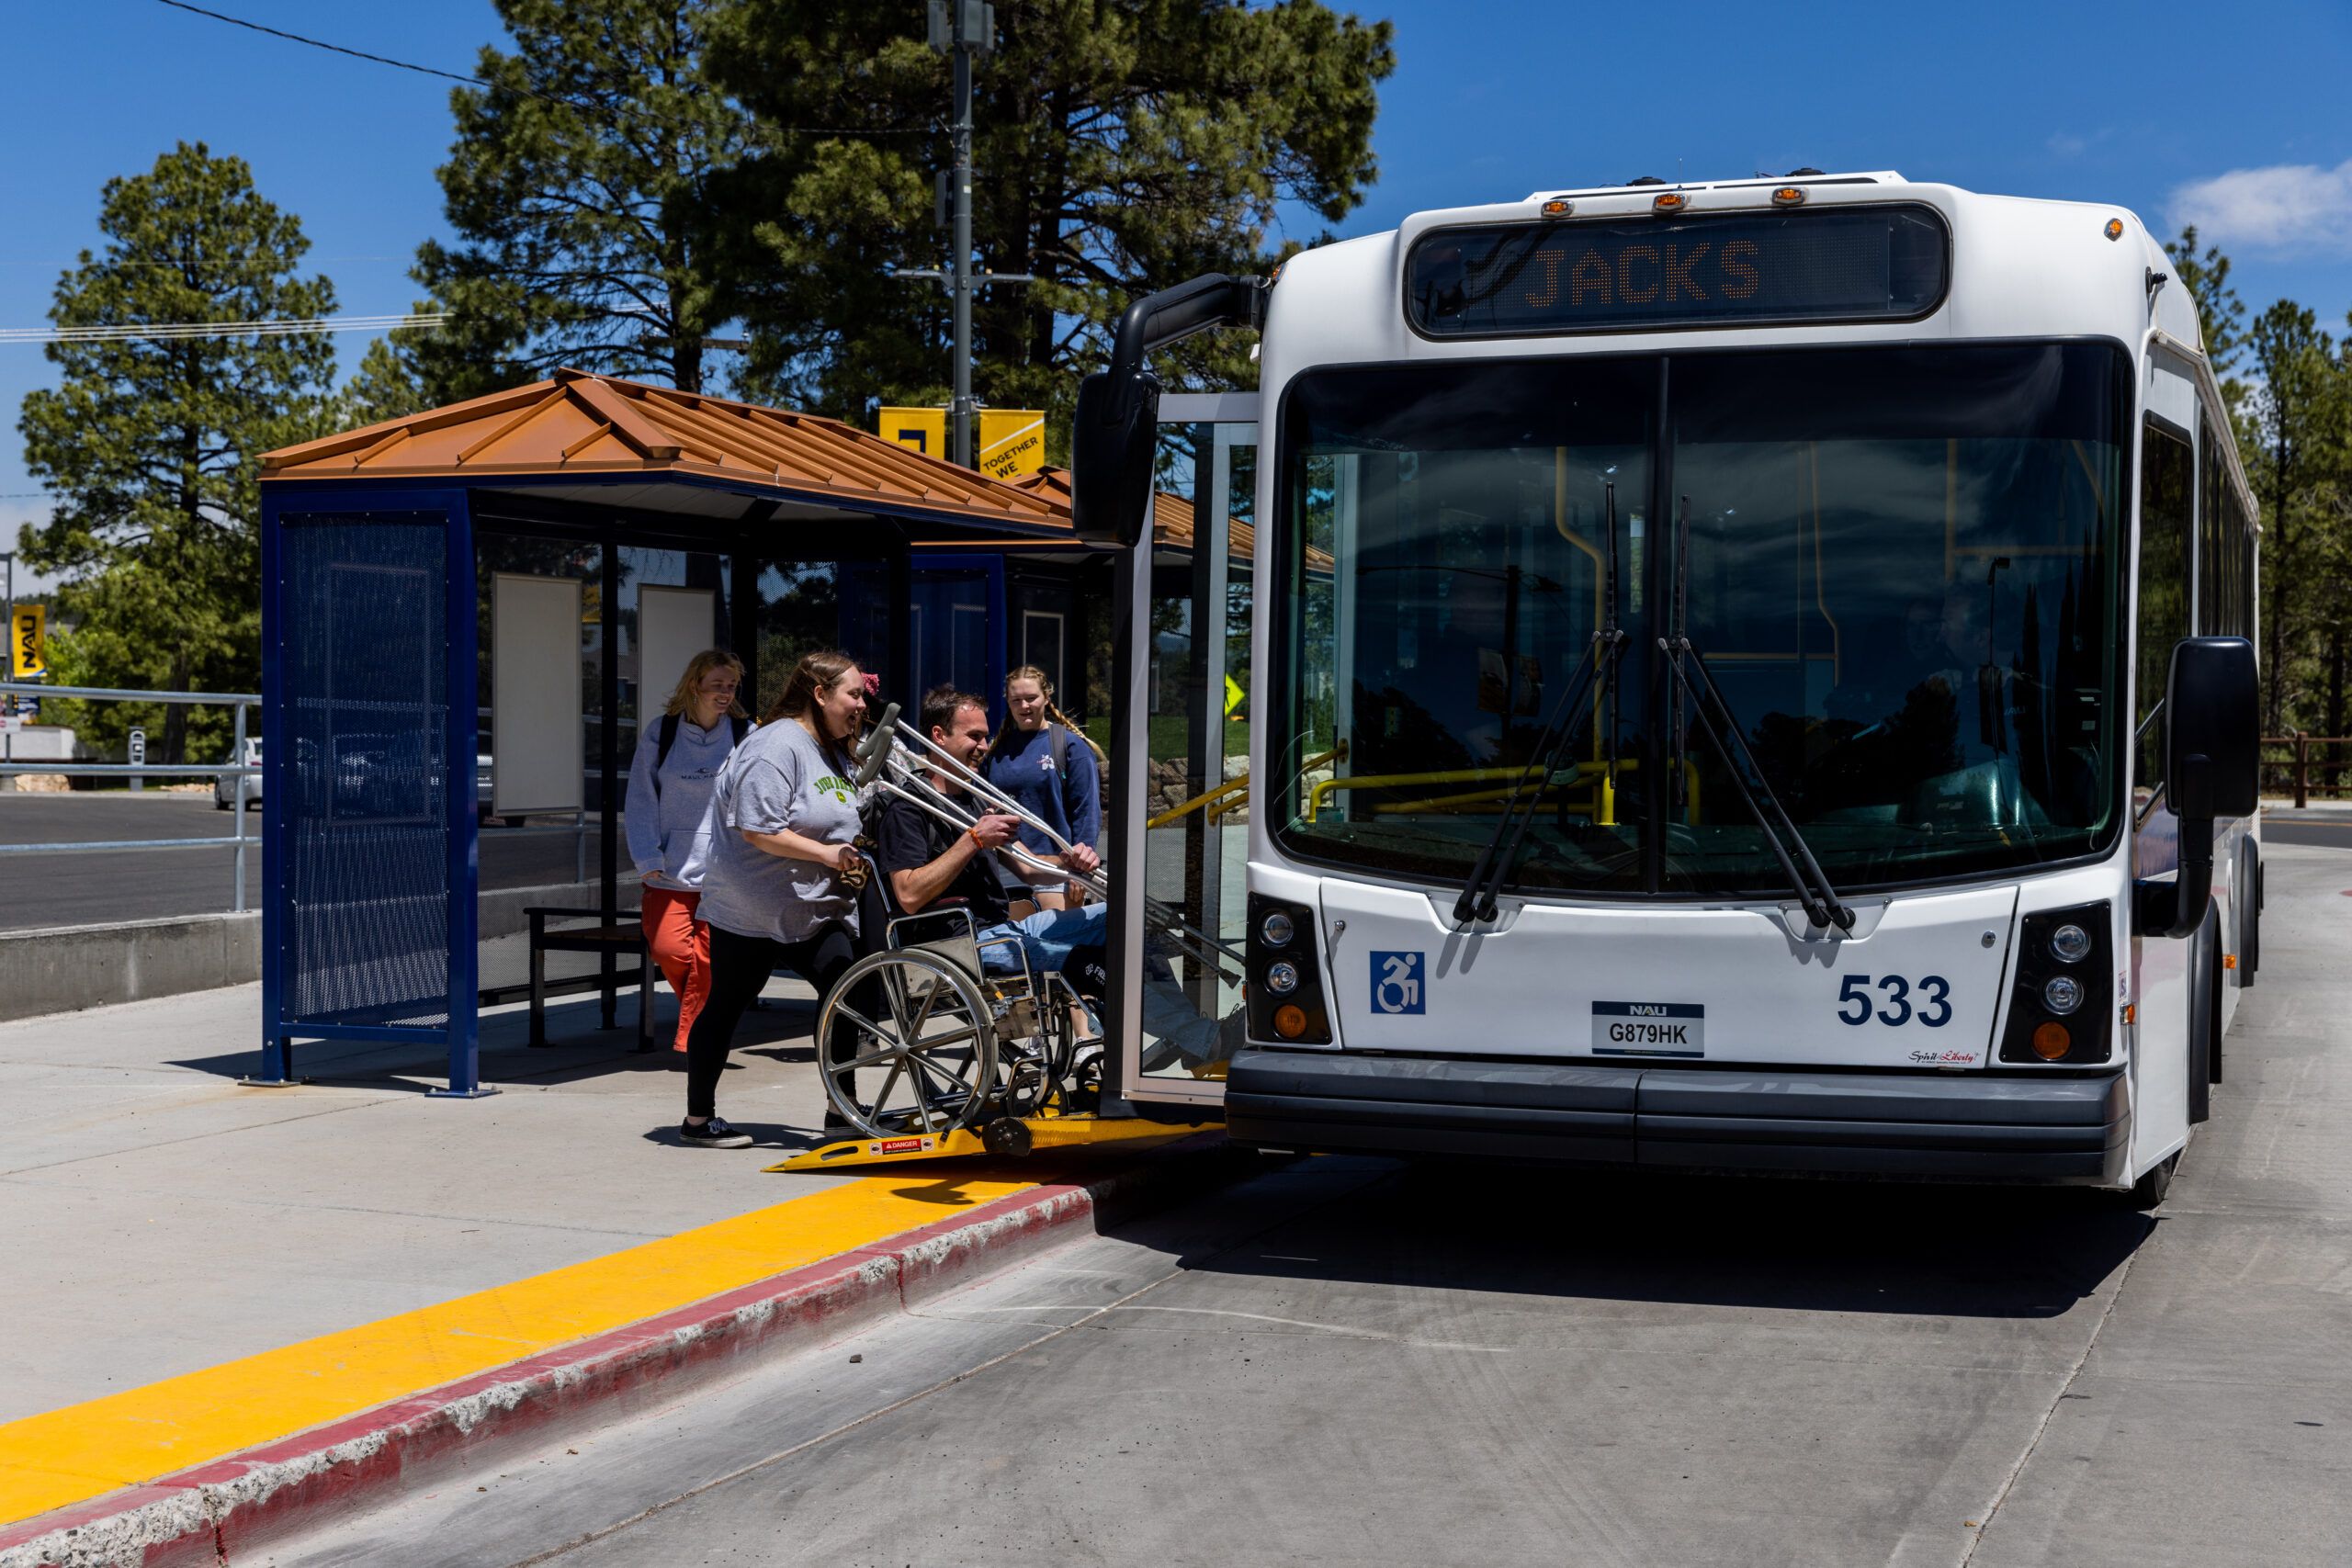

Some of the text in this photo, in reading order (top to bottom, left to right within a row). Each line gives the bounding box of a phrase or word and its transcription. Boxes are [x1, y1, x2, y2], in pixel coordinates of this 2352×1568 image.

[1524, 240, 1759, 308] JACKS
[983, 436, 1039, 471] TOGETHER
[996, 462, 1018, 479] WE
[21, 615, 37, 669] NAU
[1629, 1005, 1668, 1017] NAU
[1837, 974, 1952, 1028] 533
[1610, 1022, 1688, 1044] G879HK
[1908, 1050, 1938, 1063] Spirit
[1939, 1050, 1975, 1063] Liberty
[891, 1140, 918, 1149] DANGER
